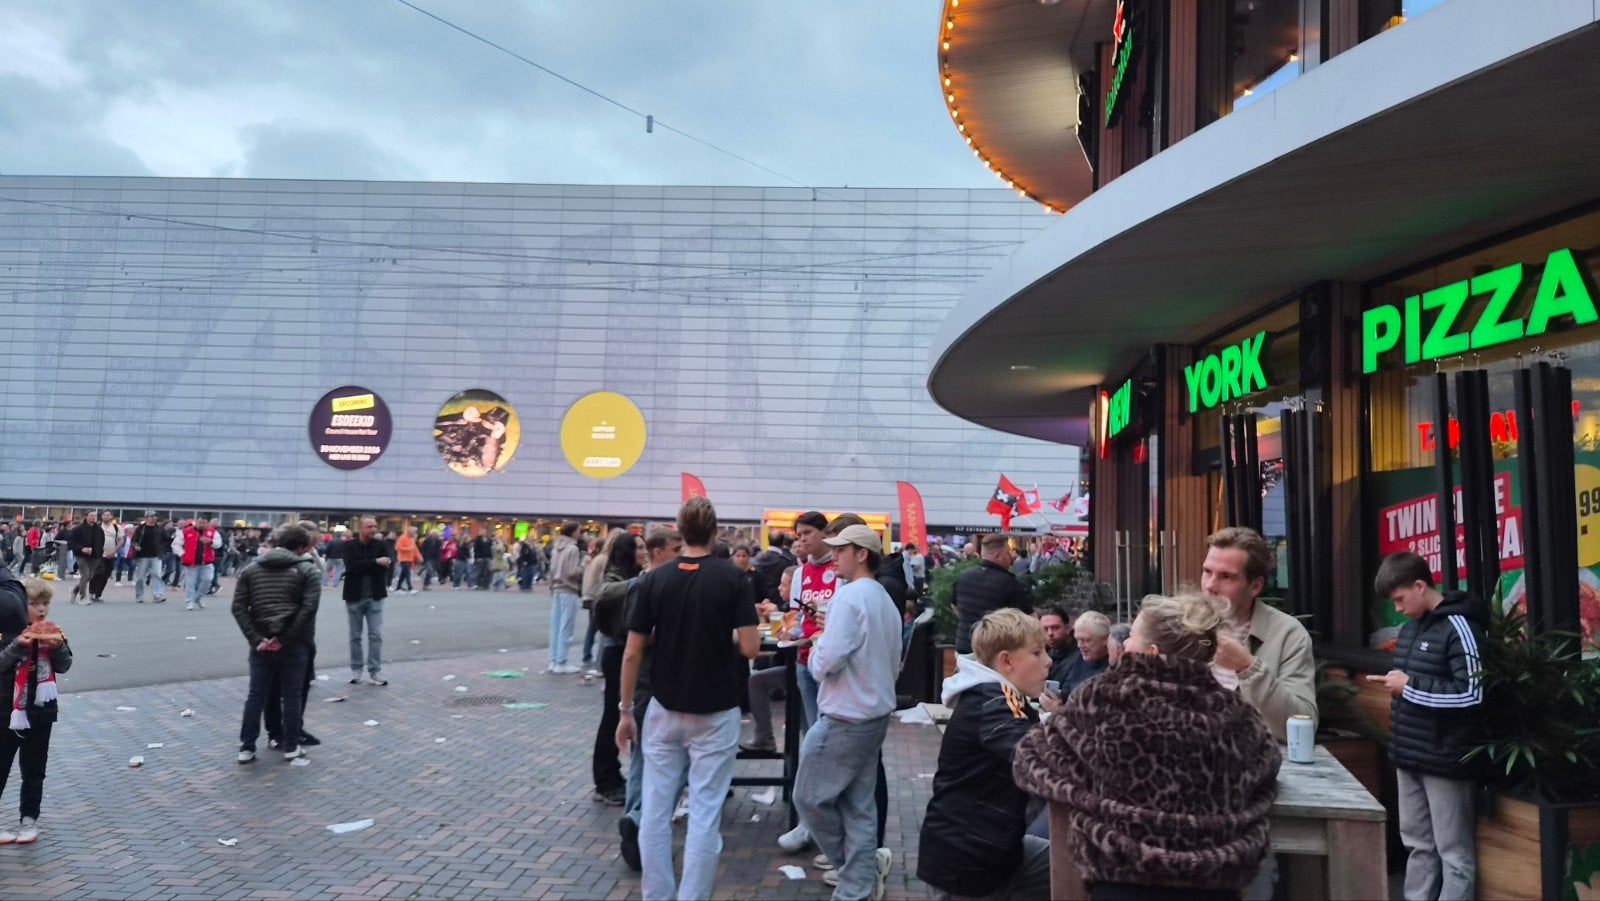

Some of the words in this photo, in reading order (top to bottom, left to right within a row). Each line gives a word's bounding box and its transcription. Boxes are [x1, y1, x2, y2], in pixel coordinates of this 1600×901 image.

[1363, 247, 1600, 375] PIZZA
[1184, 331, 1268, 413] YORK
[1109, 379, 1131, 438] NEW
[1386, 498, 1437, 543] TWIN
[1418, 534, 1441, 557] SLIC
